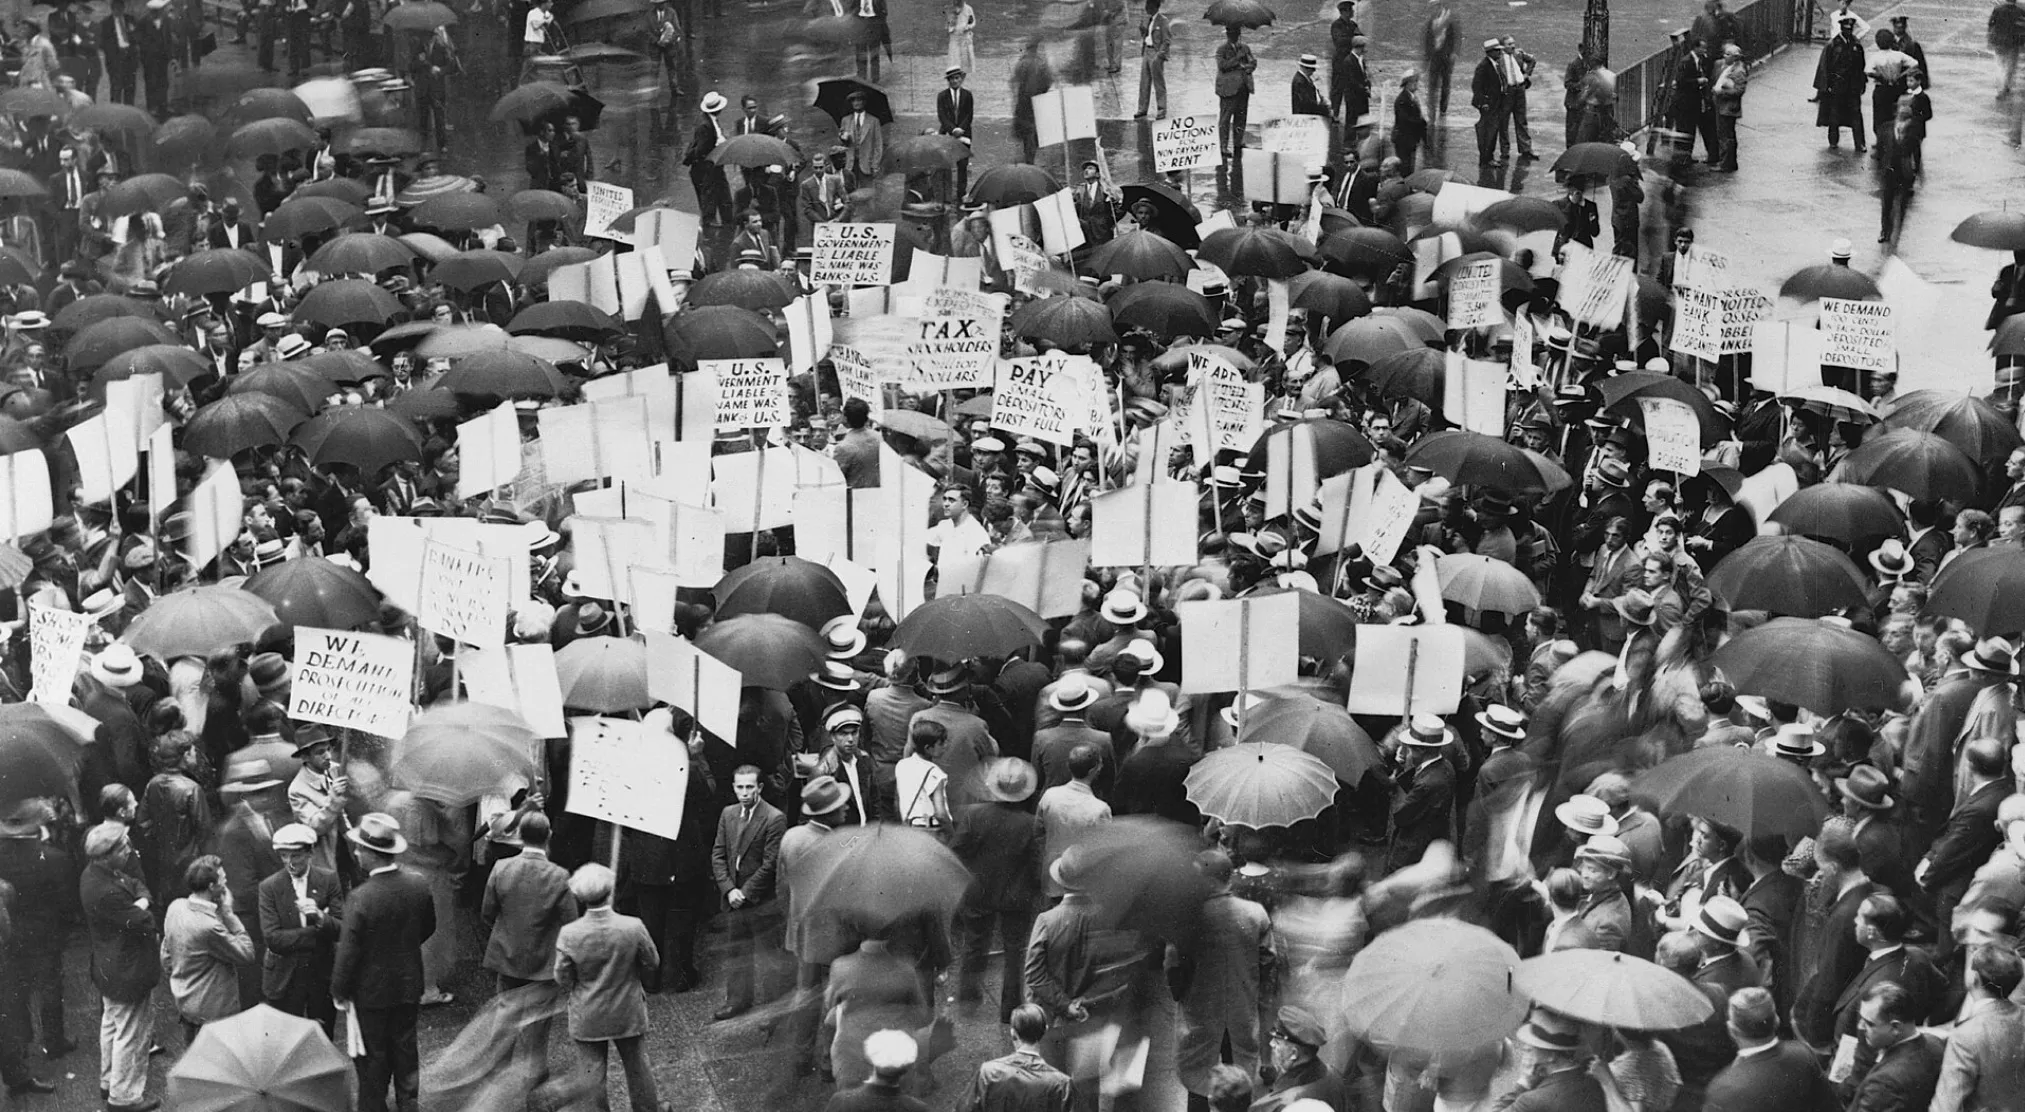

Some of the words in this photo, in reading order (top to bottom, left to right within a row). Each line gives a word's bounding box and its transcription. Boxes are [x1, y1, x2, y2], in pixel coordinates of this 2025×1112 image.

[1170, 116, 1195, 130] NO
[1156, 125, 1216, 142] EVICTIONS
[1171, 153, 1202, 168] RENT
[593, 185, 623, 202] UNITED
[840, 226, 878, 240] U.S.
[816, 239, 892, 249] GOVERNMENT
[831, 249, 879, 261] LIABLE
[829, 261, 855, 270] NAME
[858, 261, 882, 271] WAS
[813, 271, 841, 281] BANK
[854, 272, 880, 282] U.S.
[1674, 285, 1691, 301] WE
[1694, 289, 1719, 310] WANT
[1824, 301, 1840, 313] WE
[1843, 303, 1891, 317] DEMAND
[1722, 311, 1759, 325] OSSES
[919, 319, 976, 340] TAX
[731, 361, 770, 376] U.S.
[1009, 364, 1053, 388] PAY
[718, 375, 782, 388] VERNMENT
[722, 387, 766, 400] LIABLE
[1007, 383, 1056, 403] SMALL
[754, 398, 778, 409] WAS
[997, 394, 1066, 421] DEPOSITORS
[716, 412, 739, 424] ANK
[754, 409, 781, 424] U.S.
[994, 412, 1027, 427] FIRST
[1034, 418, 1062, 433] FULL
